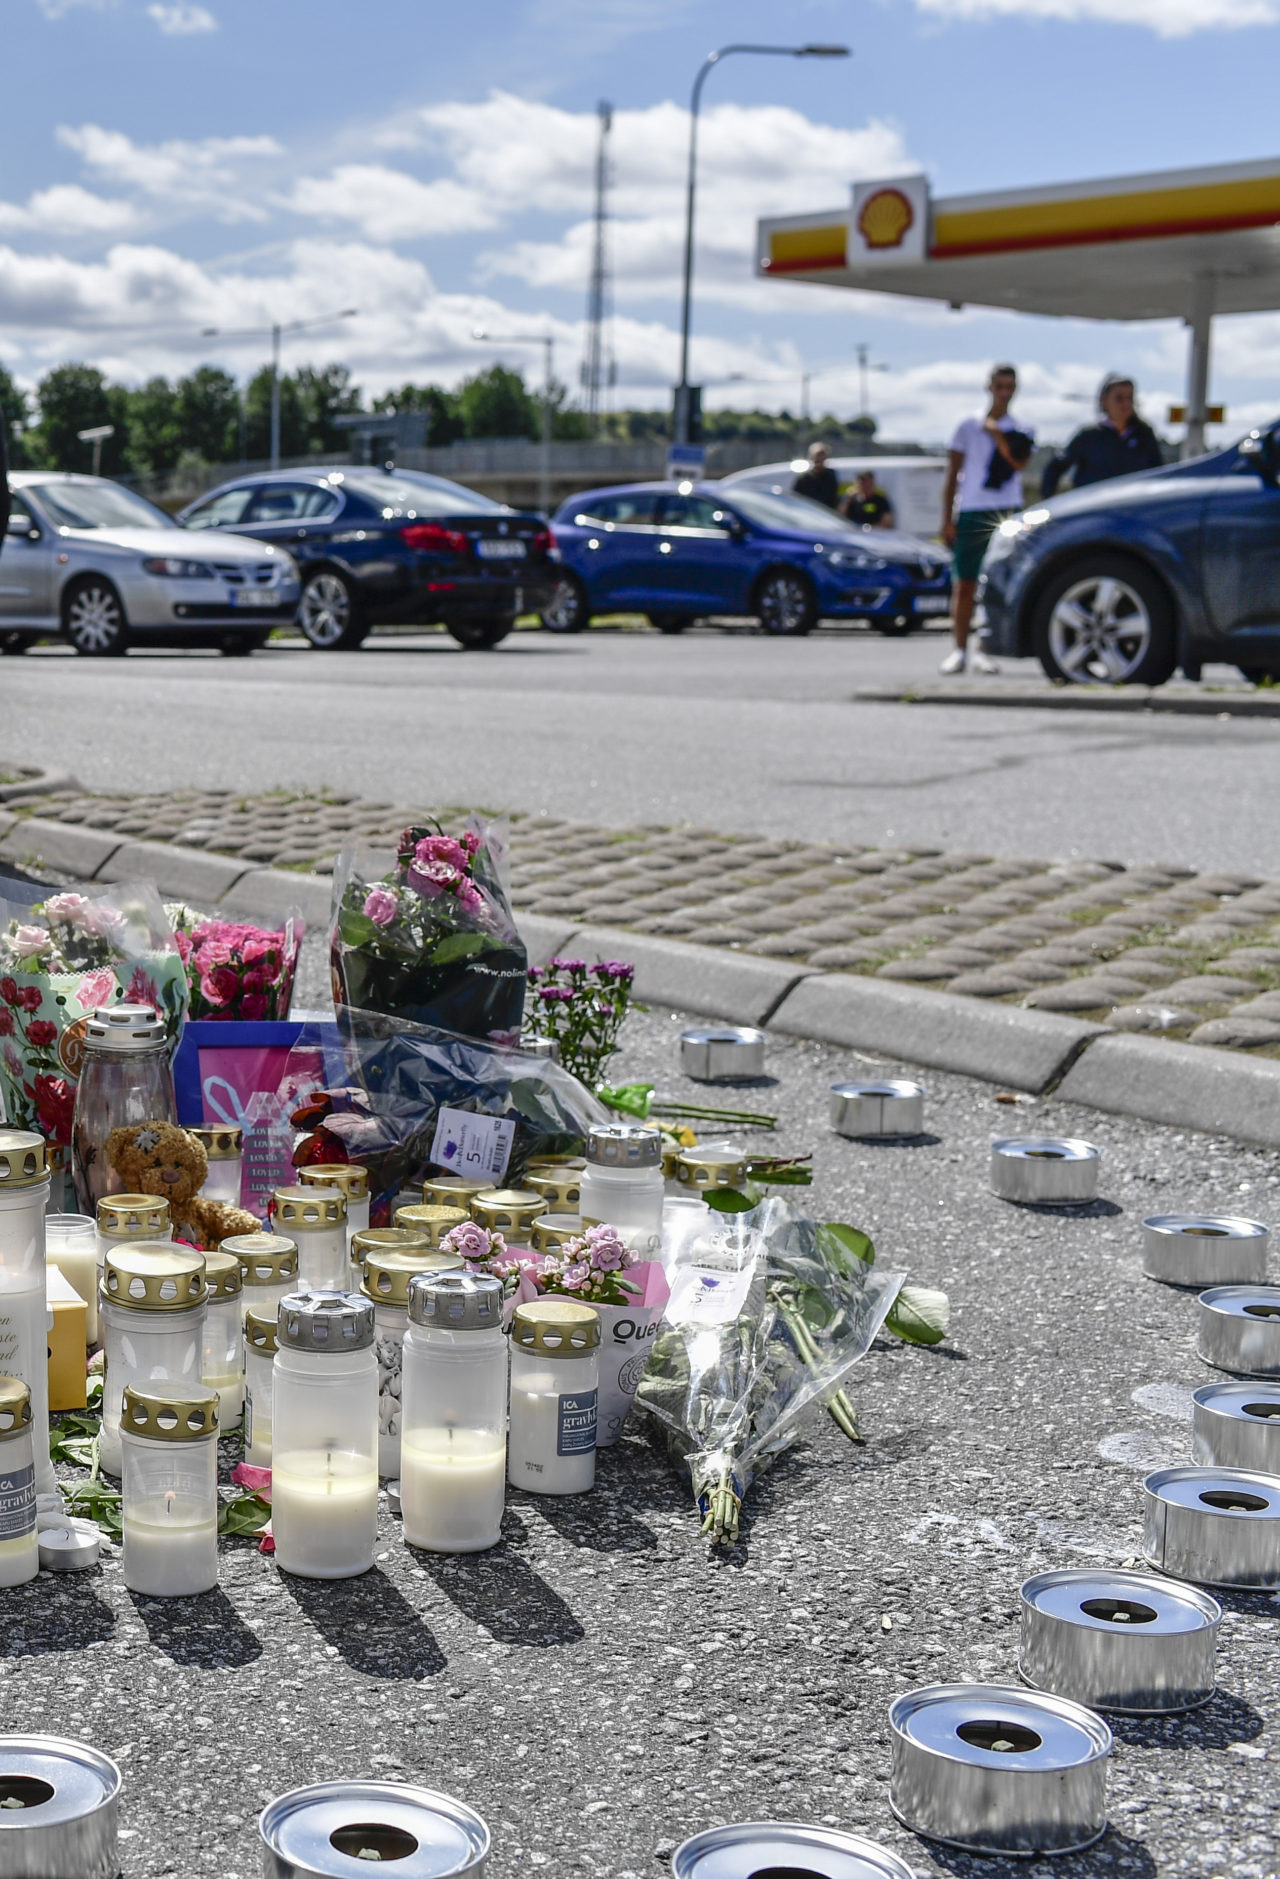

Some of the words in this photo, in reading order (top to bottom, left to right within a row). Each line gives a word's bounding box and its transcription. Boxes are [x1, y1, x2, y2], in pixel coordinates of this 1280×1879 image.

[466, 1152, 481, 1164] 5
[612, 1319, 660, 1344] Que
[563, 1400, 578, 1410] ICA
